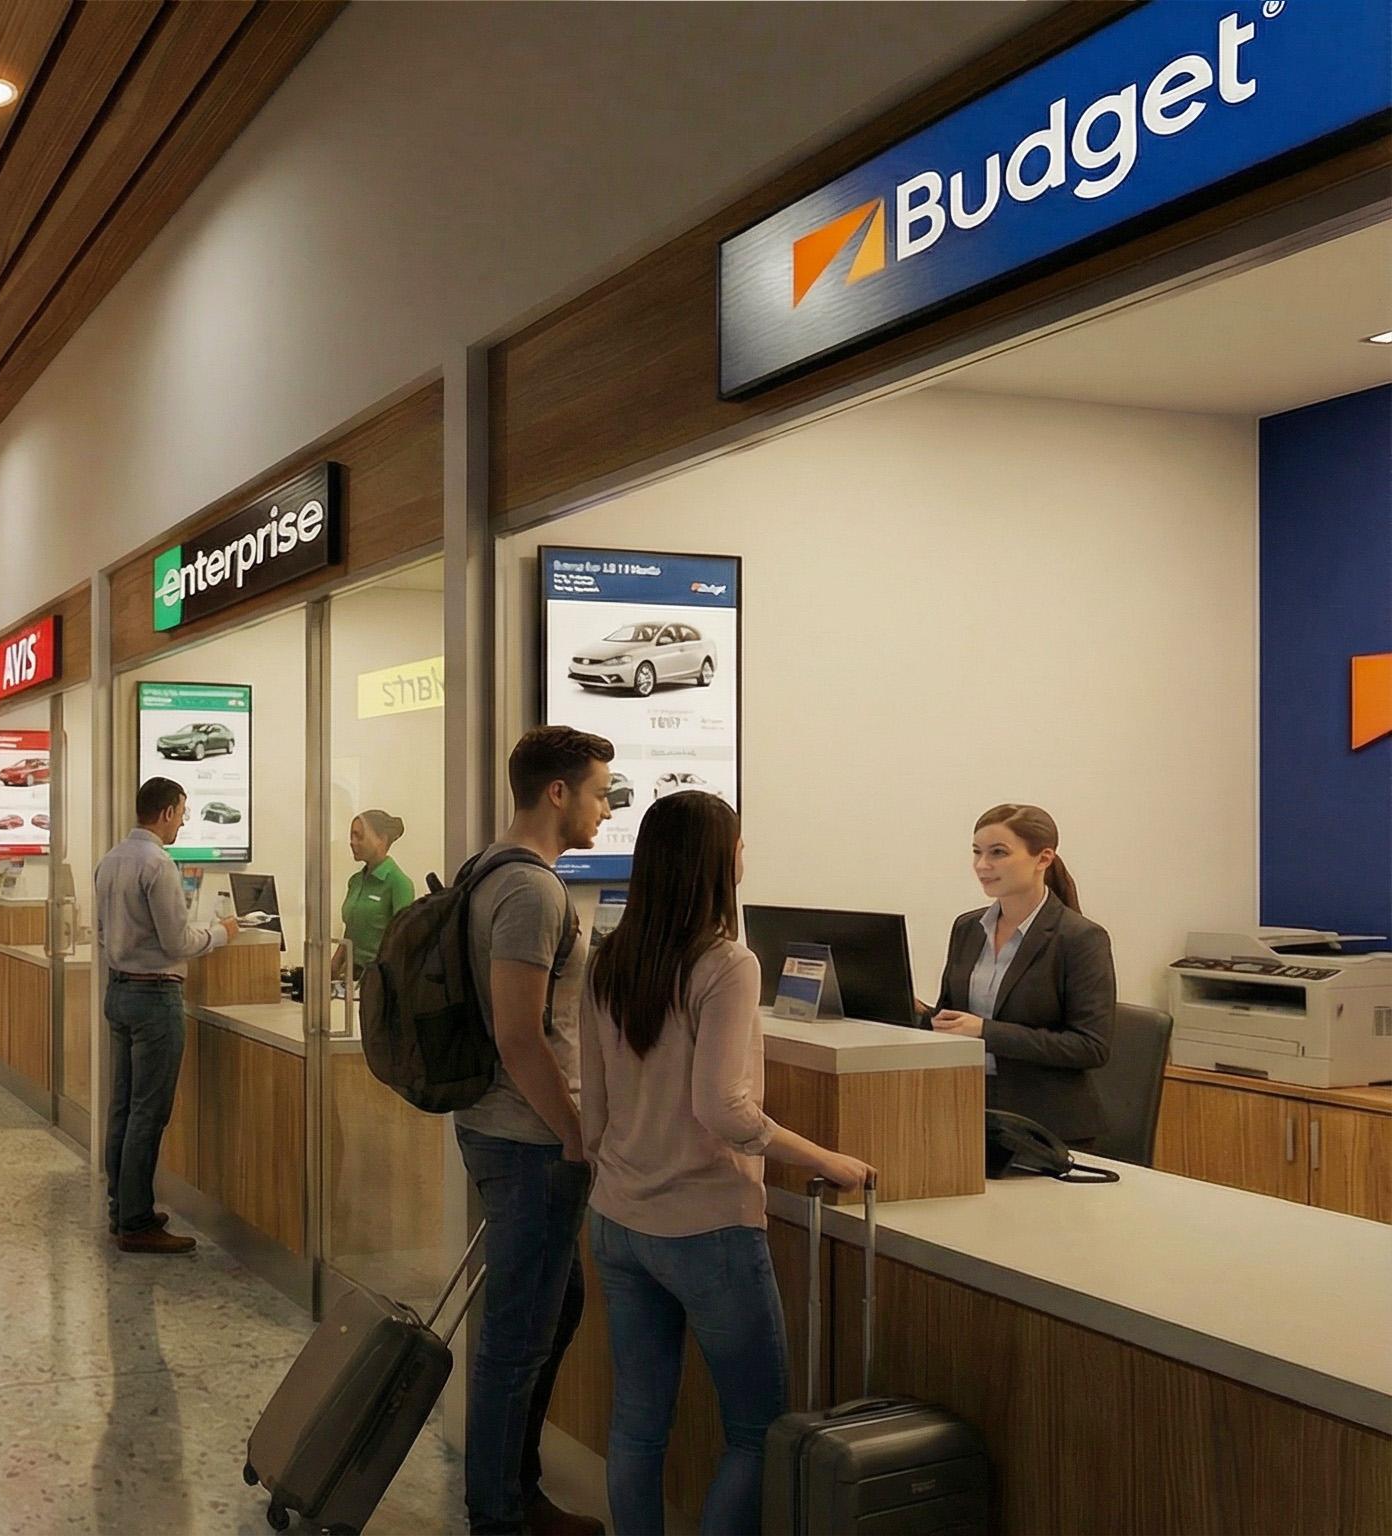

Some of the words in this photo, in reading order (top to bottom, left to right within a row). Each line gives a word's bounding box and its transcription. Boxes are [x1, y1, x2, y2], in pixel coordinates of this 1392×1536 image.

[896, 12, 1257, 262] Budget
[154, 499, 325, 607] enterprise
[2, 632, 37, 691] AVIS
